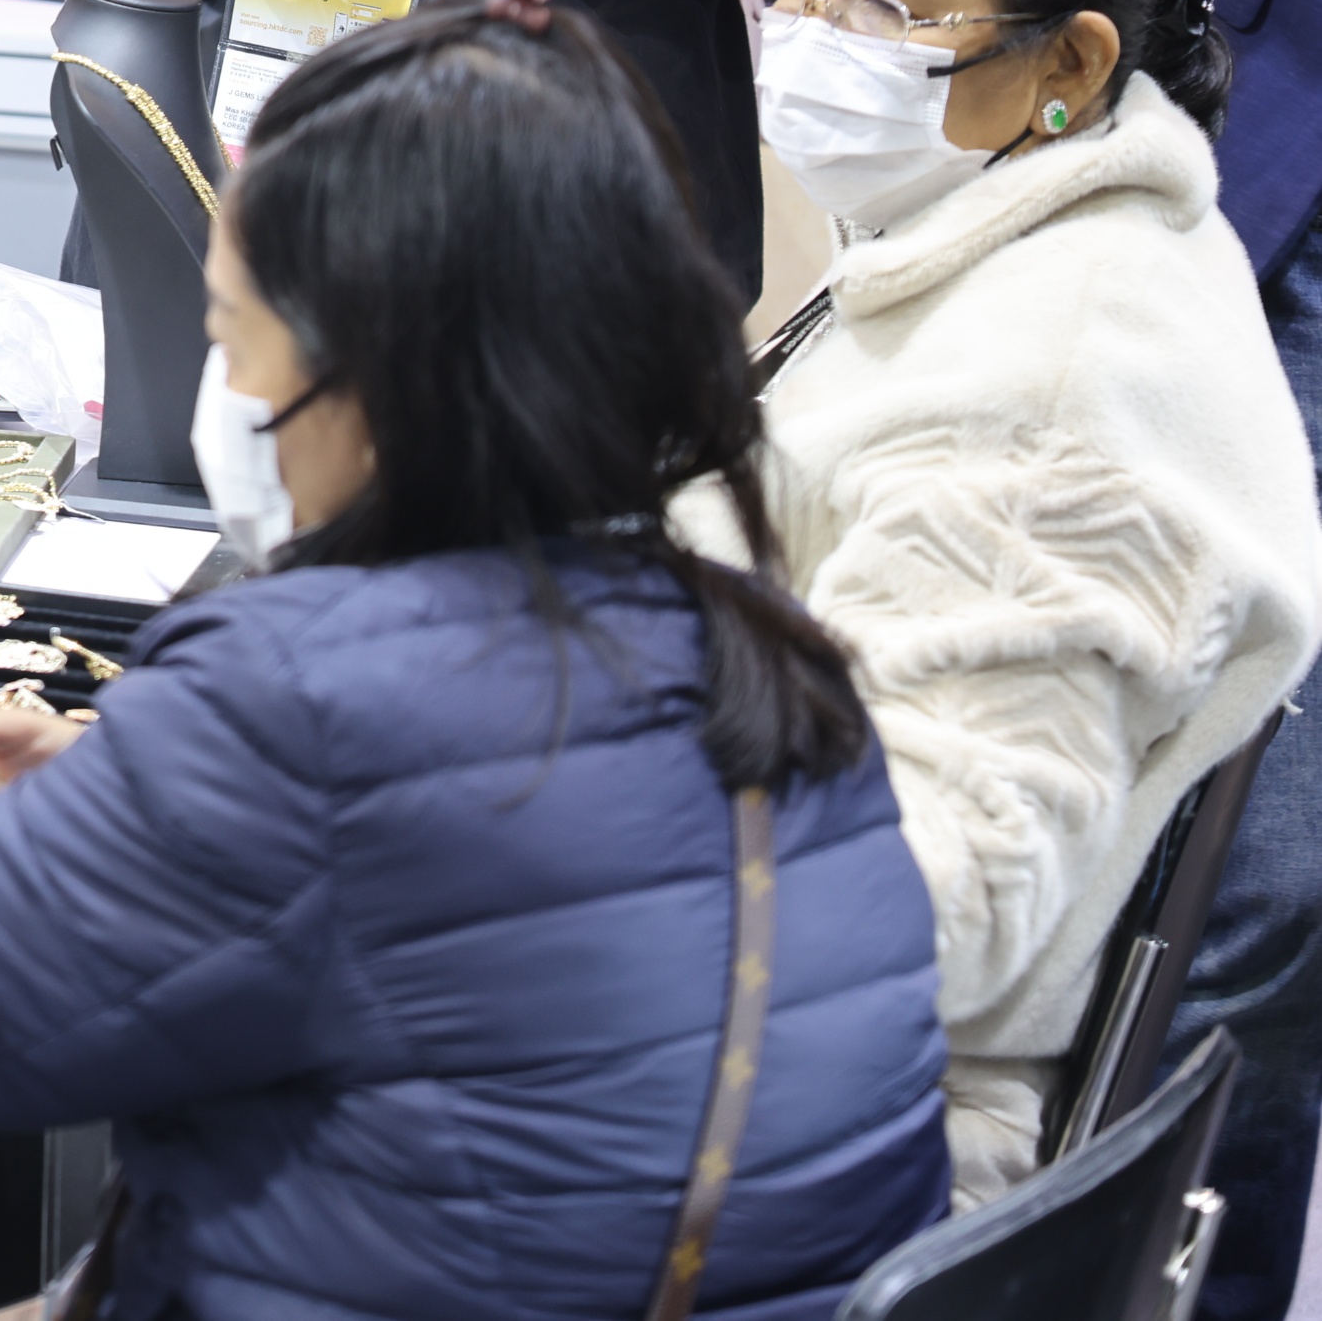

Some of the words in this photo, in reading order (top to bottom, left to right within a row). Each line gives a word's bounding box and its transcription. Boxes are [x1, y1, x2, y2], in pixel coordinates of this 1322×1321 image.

[239, 18, 303, 36] sourcing.hktdc.com
[234, 90, 255, 99] GEMS
[224, 112, 238, 120] CEC
[222, 121, 246, 131] KOREA
